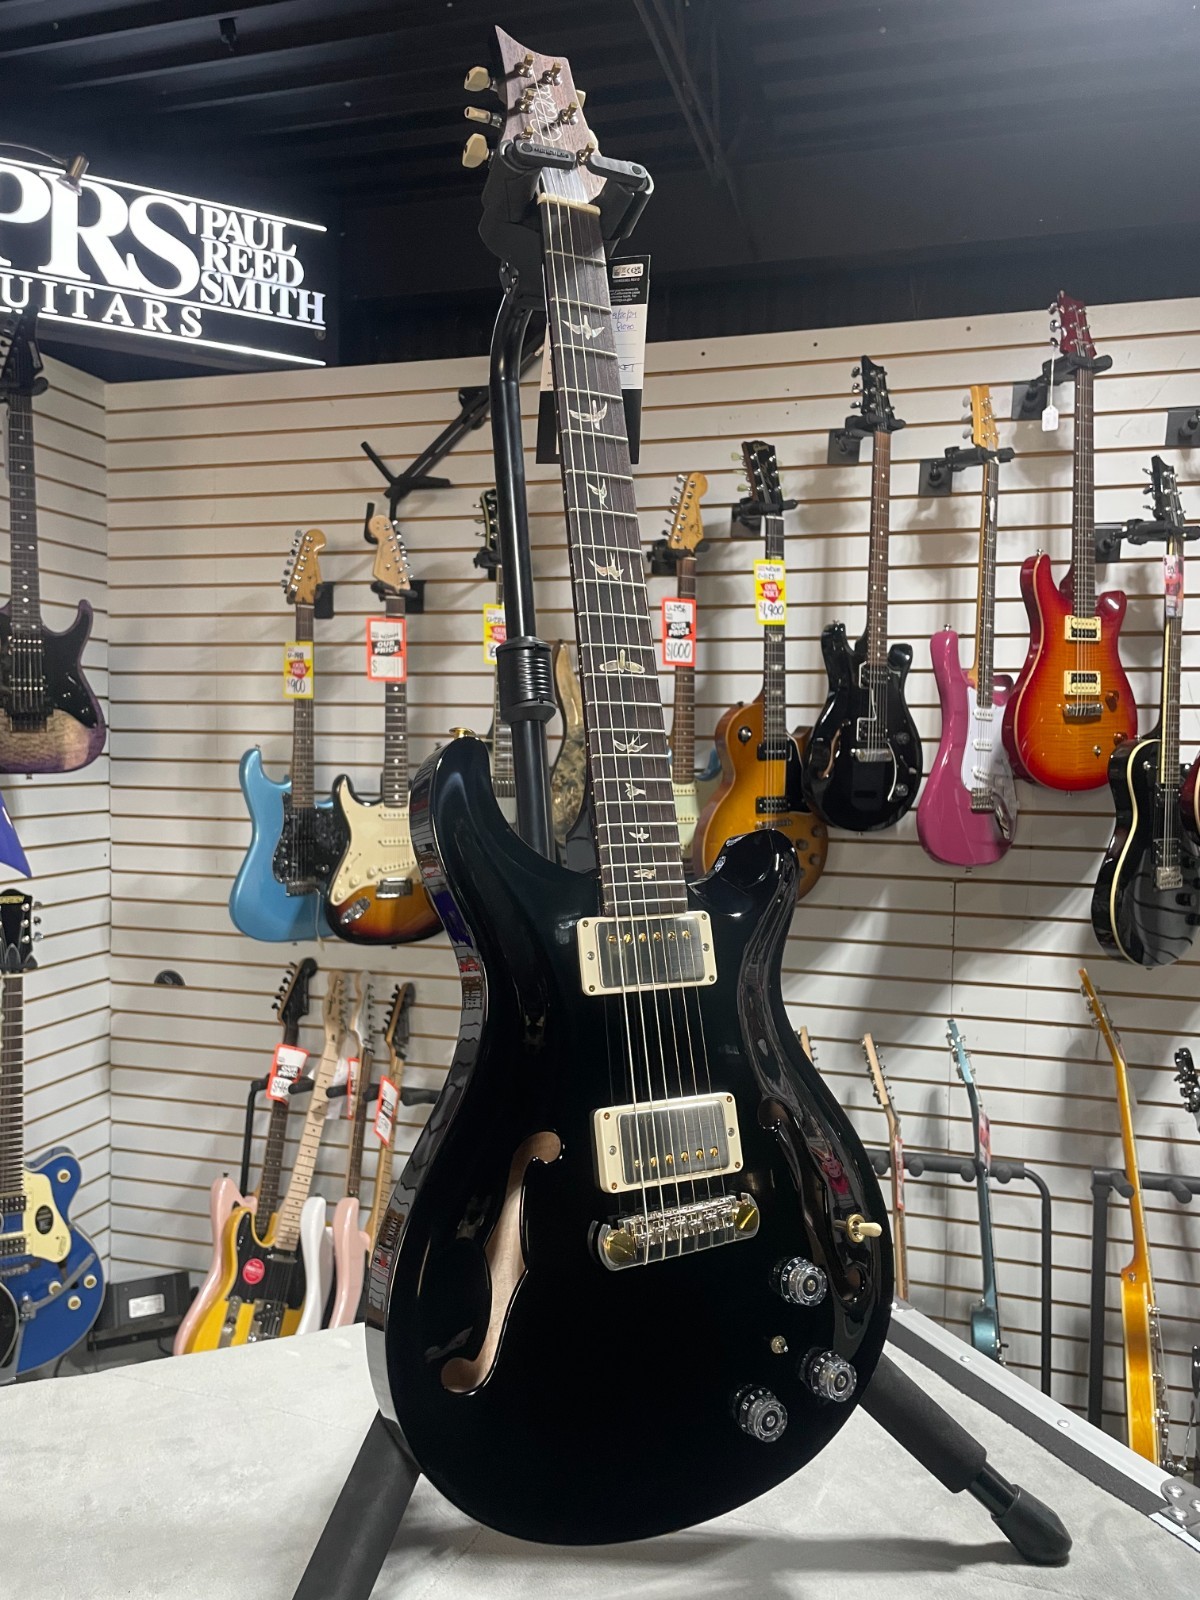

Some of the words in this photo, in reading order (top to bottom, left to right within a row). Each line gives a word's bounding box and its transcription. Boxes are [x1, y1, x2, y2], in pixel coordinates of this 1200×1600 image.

[0, 164, 200, 297] PRS
[200, 205, 297, 256] PAUL
[201, 238, 305, 288] REED
[0, 276, 203, 337] UITARS
[200, 270, 326, 325] SMITH
[668, 628, 690, 637] PRICE
[670, 622, 687, 630] OUR
[374, 645, 399, 654] PRICE
[377, 640, 395, 648] OUR
[666, 641, 691, 659] $1000
